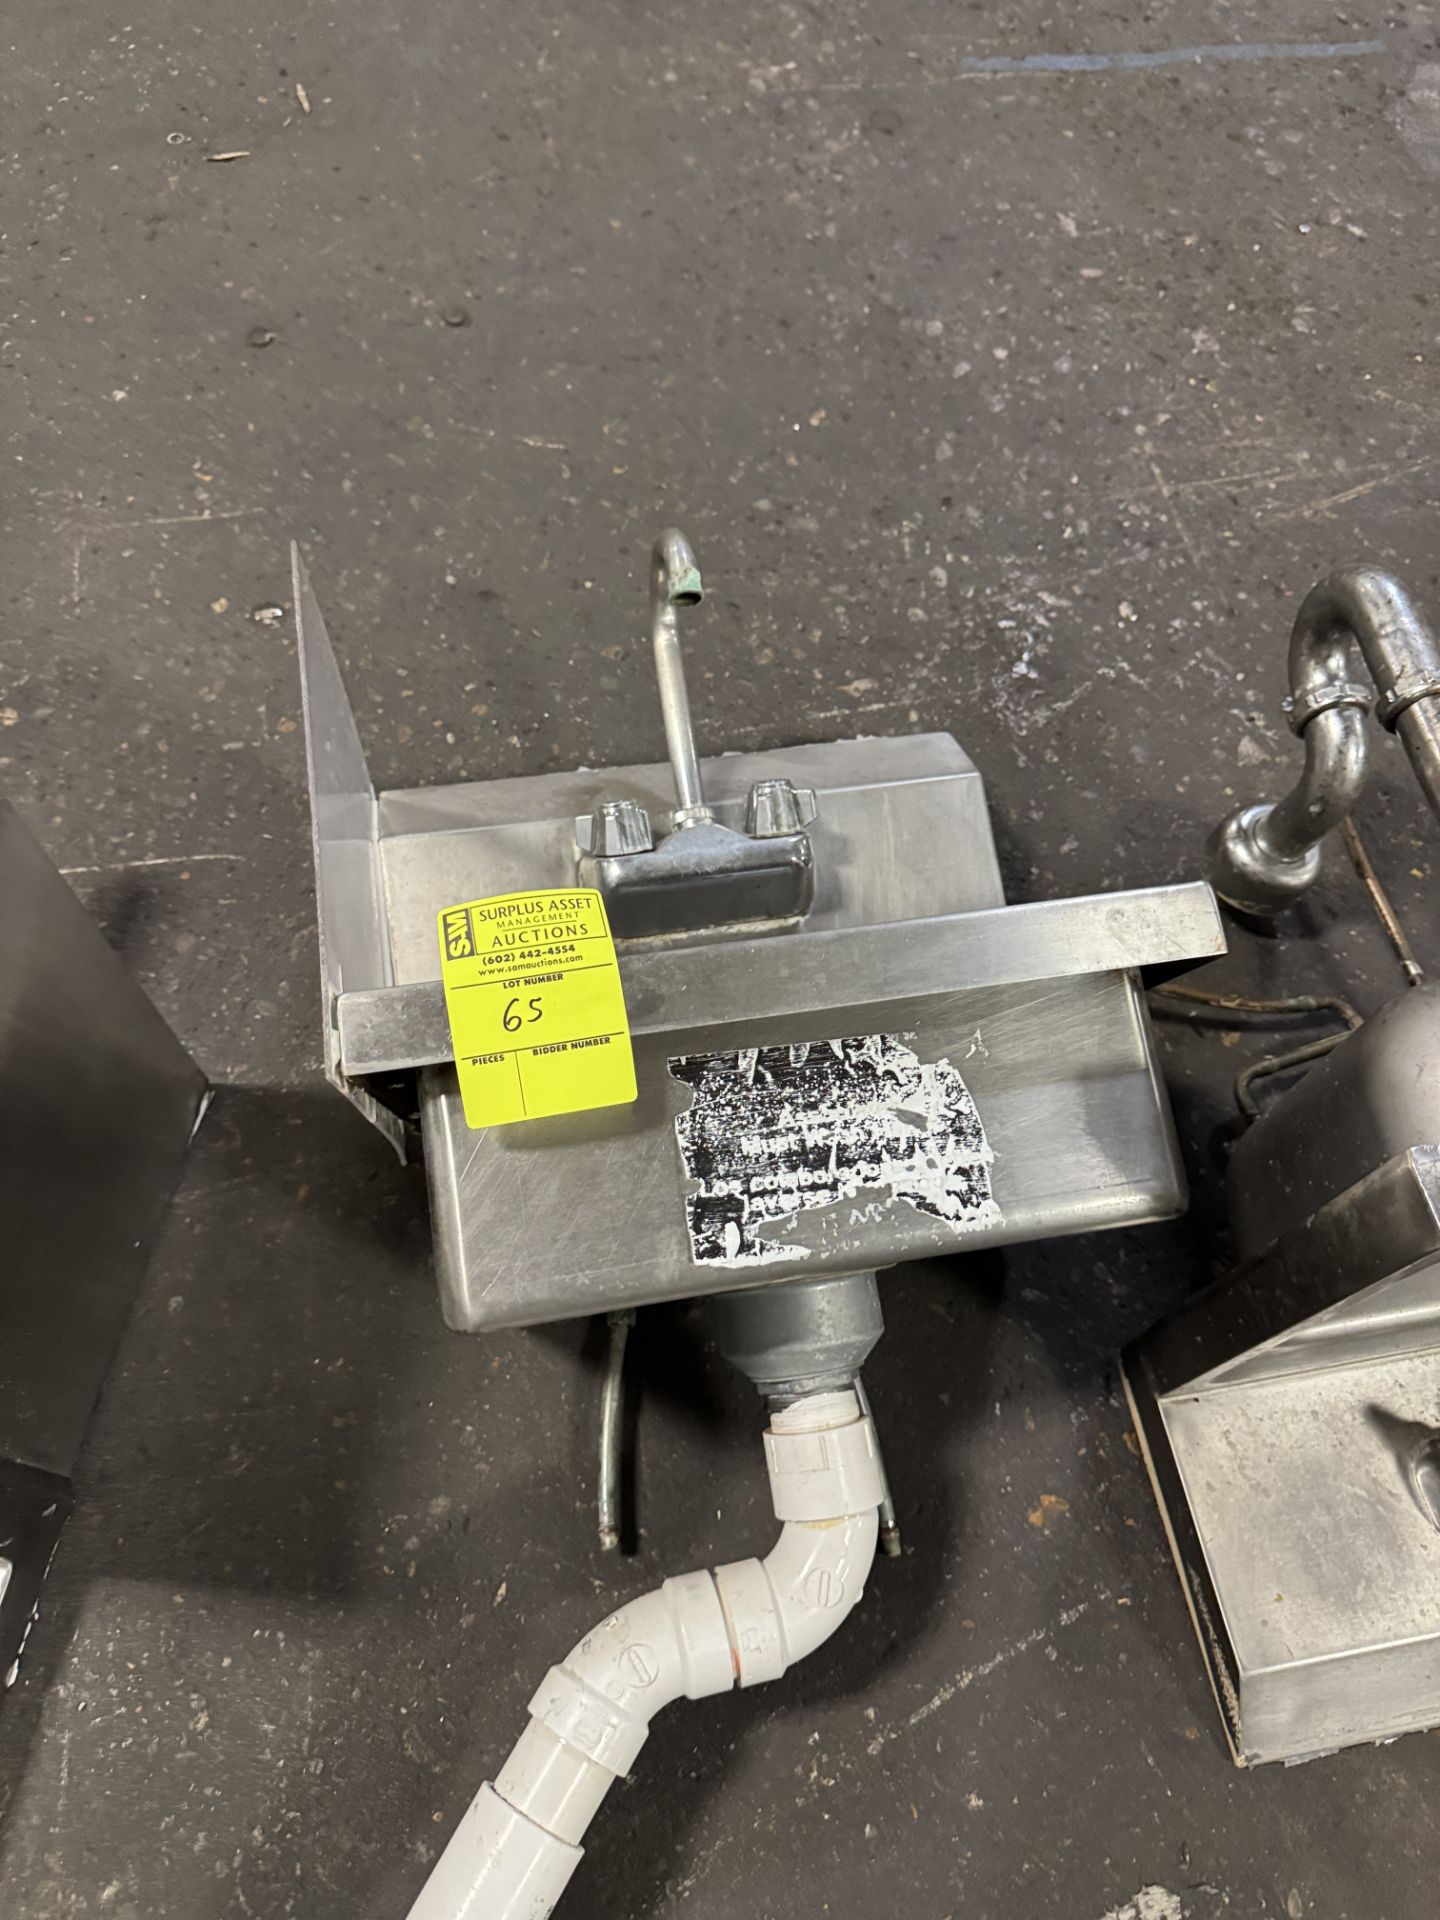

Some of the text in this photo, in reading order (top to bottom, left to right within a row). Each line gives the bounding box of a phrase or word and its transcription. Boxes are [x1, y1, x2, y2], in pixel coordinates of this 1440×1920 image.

[479, 897, 592, 922] SURPLUS ASSET
[496, 911, 580, 929] MANAGEMENT
[492, 923, 588, 948] AUCTIONS
[478, 954, 583, 977] www.samauctions.com
[482, 944, 576, 967] (602) 442-4554
[503, 973, 564, 989] LOT NUMBER
[503, 997, 543, 1032] 65
[532, 1036, 611, 1056] BIDDER NUMBER
[472, 1054, 505, 1066] PIECES
